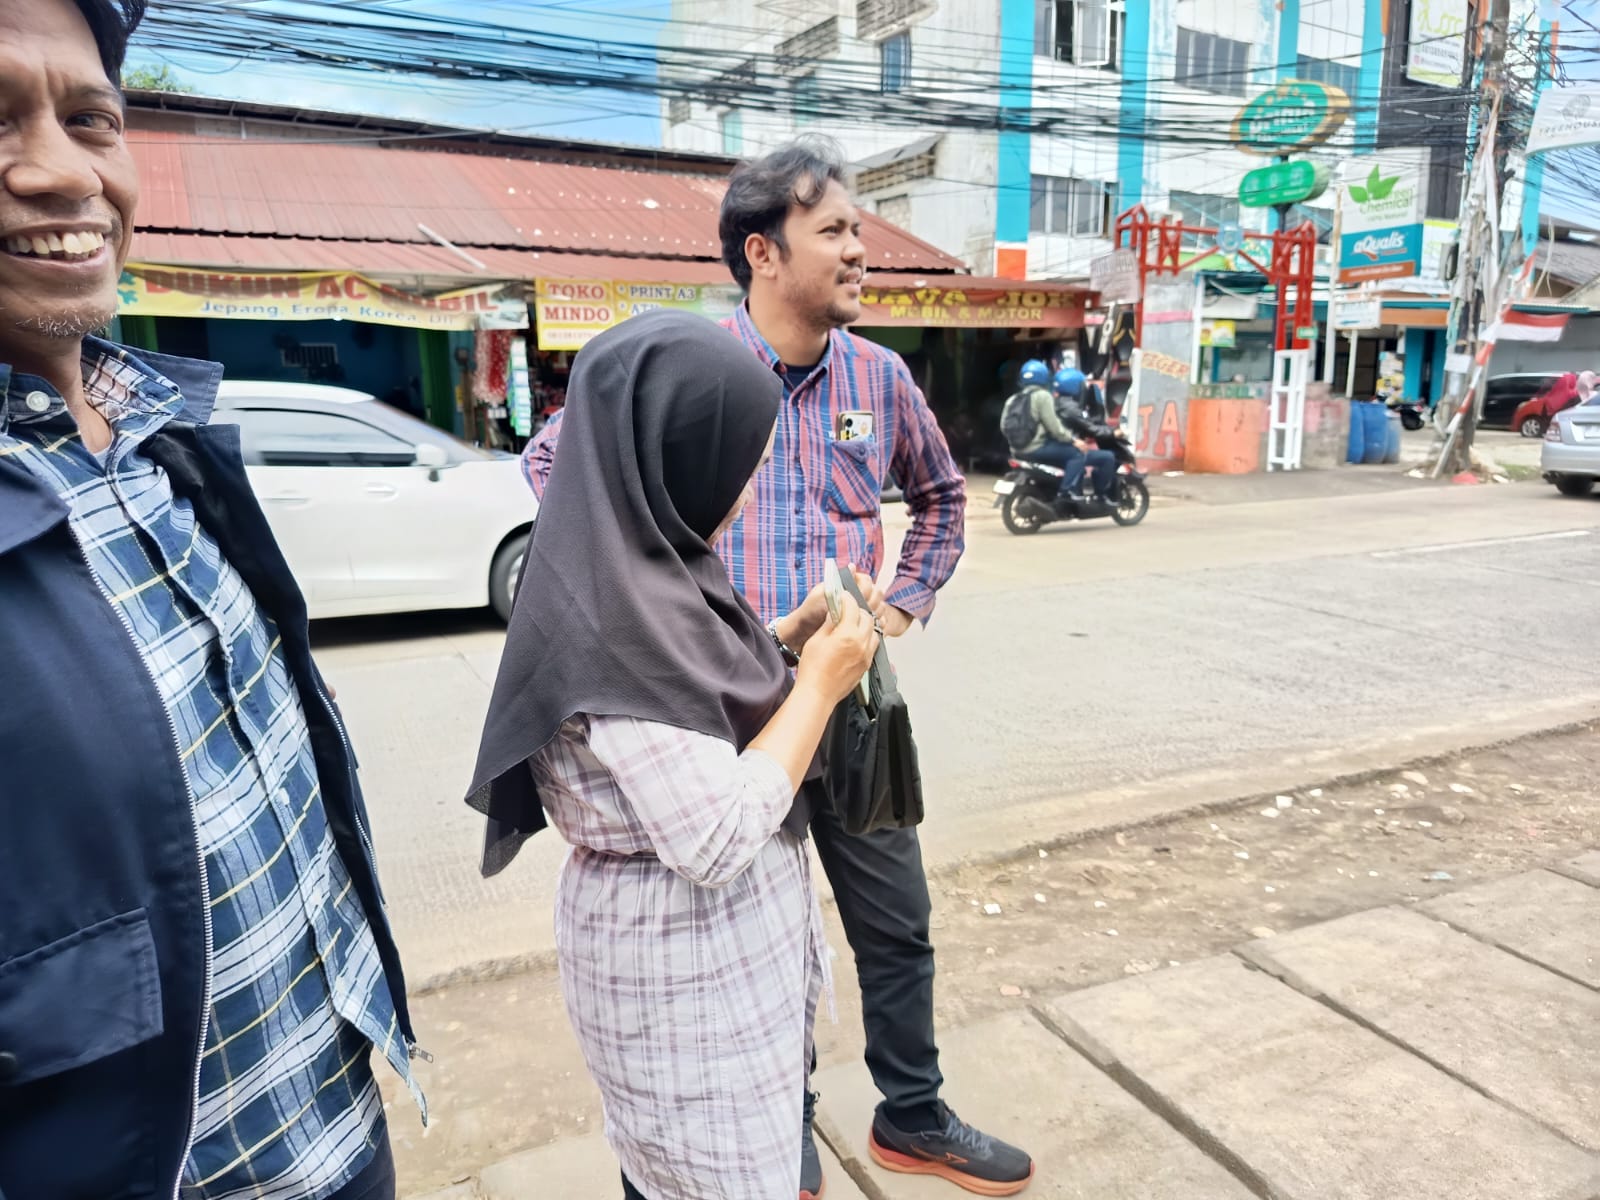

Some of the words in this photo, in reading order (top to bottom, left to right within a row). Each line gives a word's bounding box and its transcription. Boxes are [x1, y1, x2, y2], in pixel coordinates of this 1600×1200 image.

[316, 274, 368, 300] AC
[548, 284, 605, 300] TOKO
[629, 285, 673, 299] PRINT
[677, 287, 696, 300] A3
[544, 304, 610, 322] MINDO
[978, 307, 1042, 320] MOTOR
